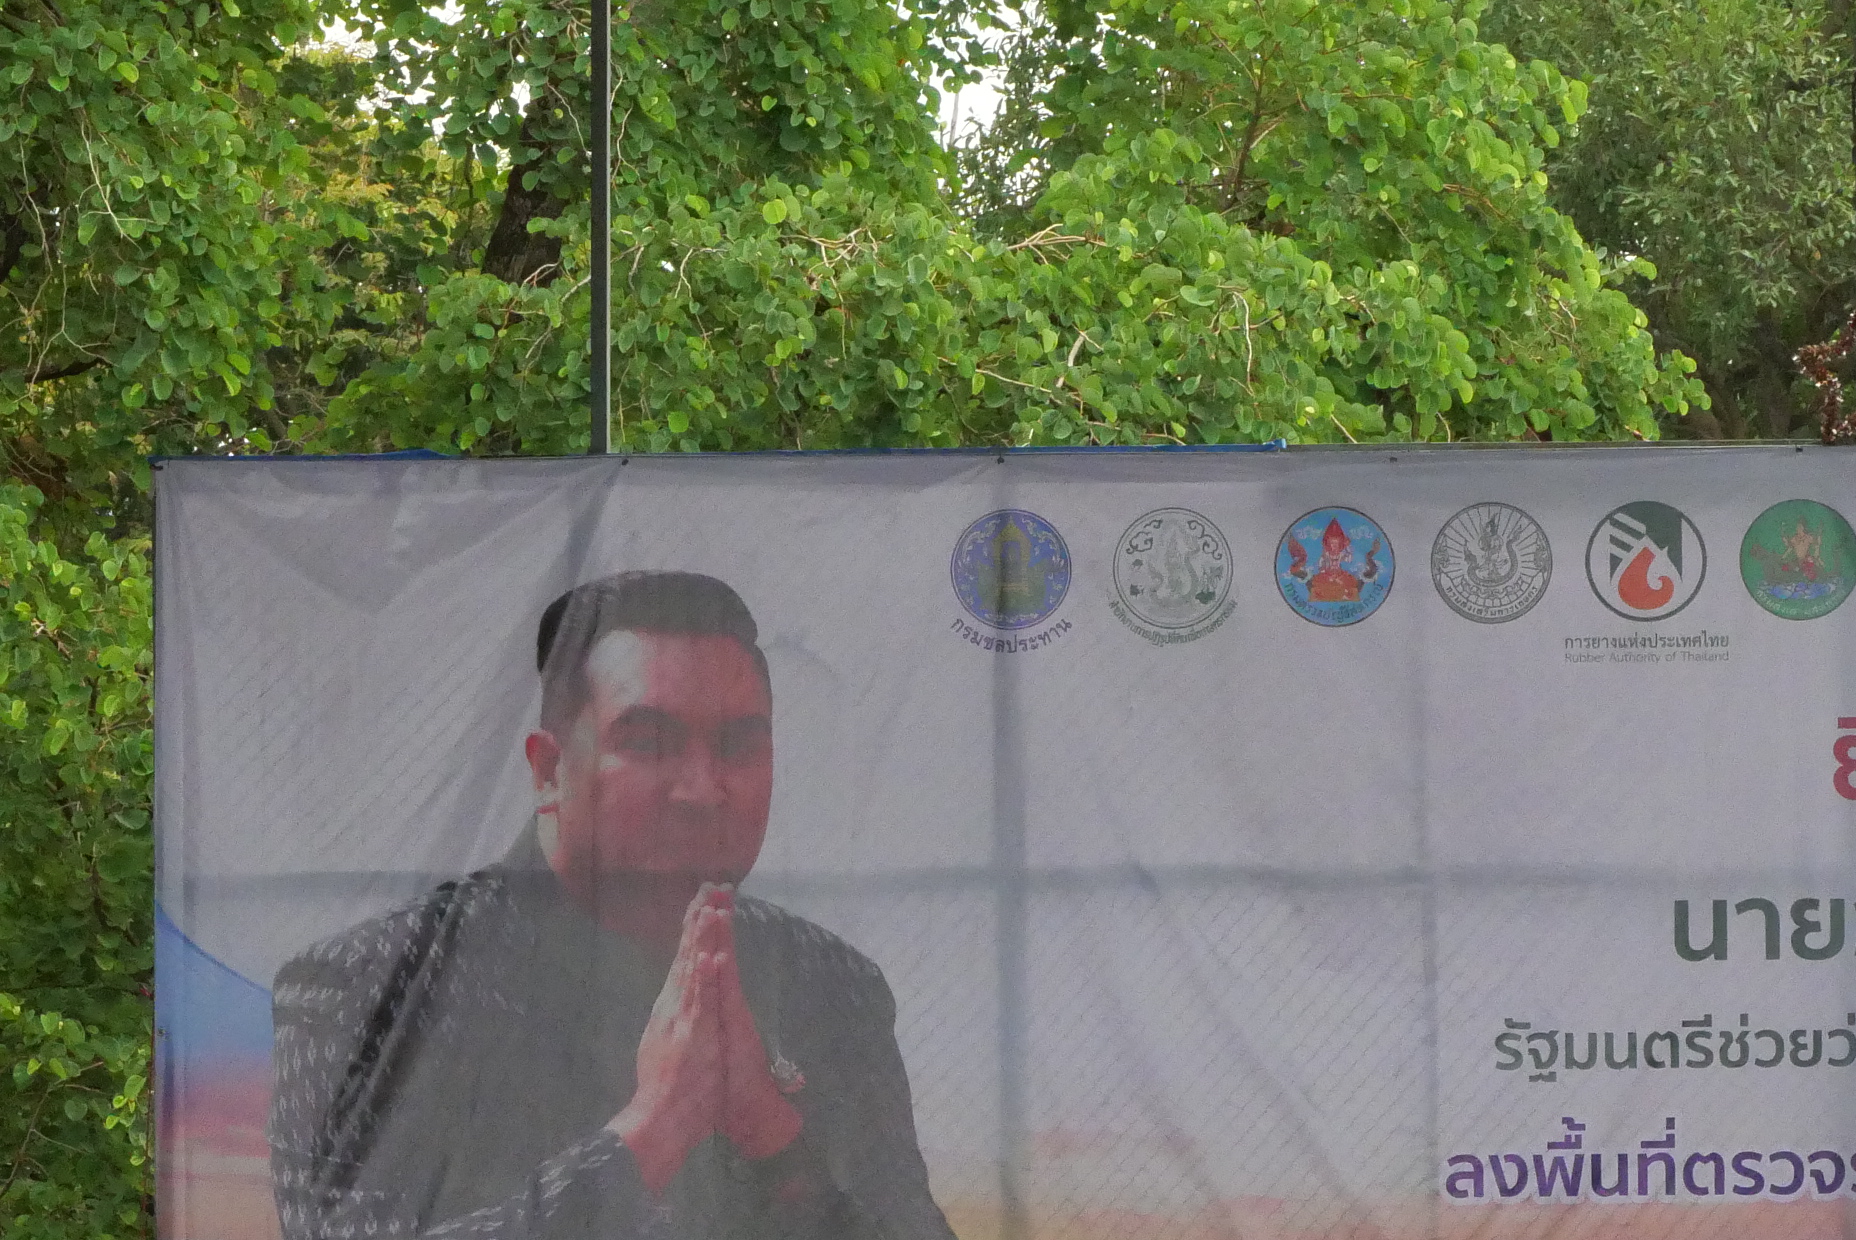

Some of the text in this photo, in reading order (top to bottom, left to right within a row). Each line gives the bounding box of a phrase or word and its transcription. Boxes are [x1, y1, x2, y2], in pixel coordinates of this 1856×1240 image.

[951, 616, 1073, 653] กรมชลประทาน
[1564, 630, 1730, 650] การยางแห่งประเทศไทย
[1564, 651, 1730, 664] Rubber Authority of Thailand
